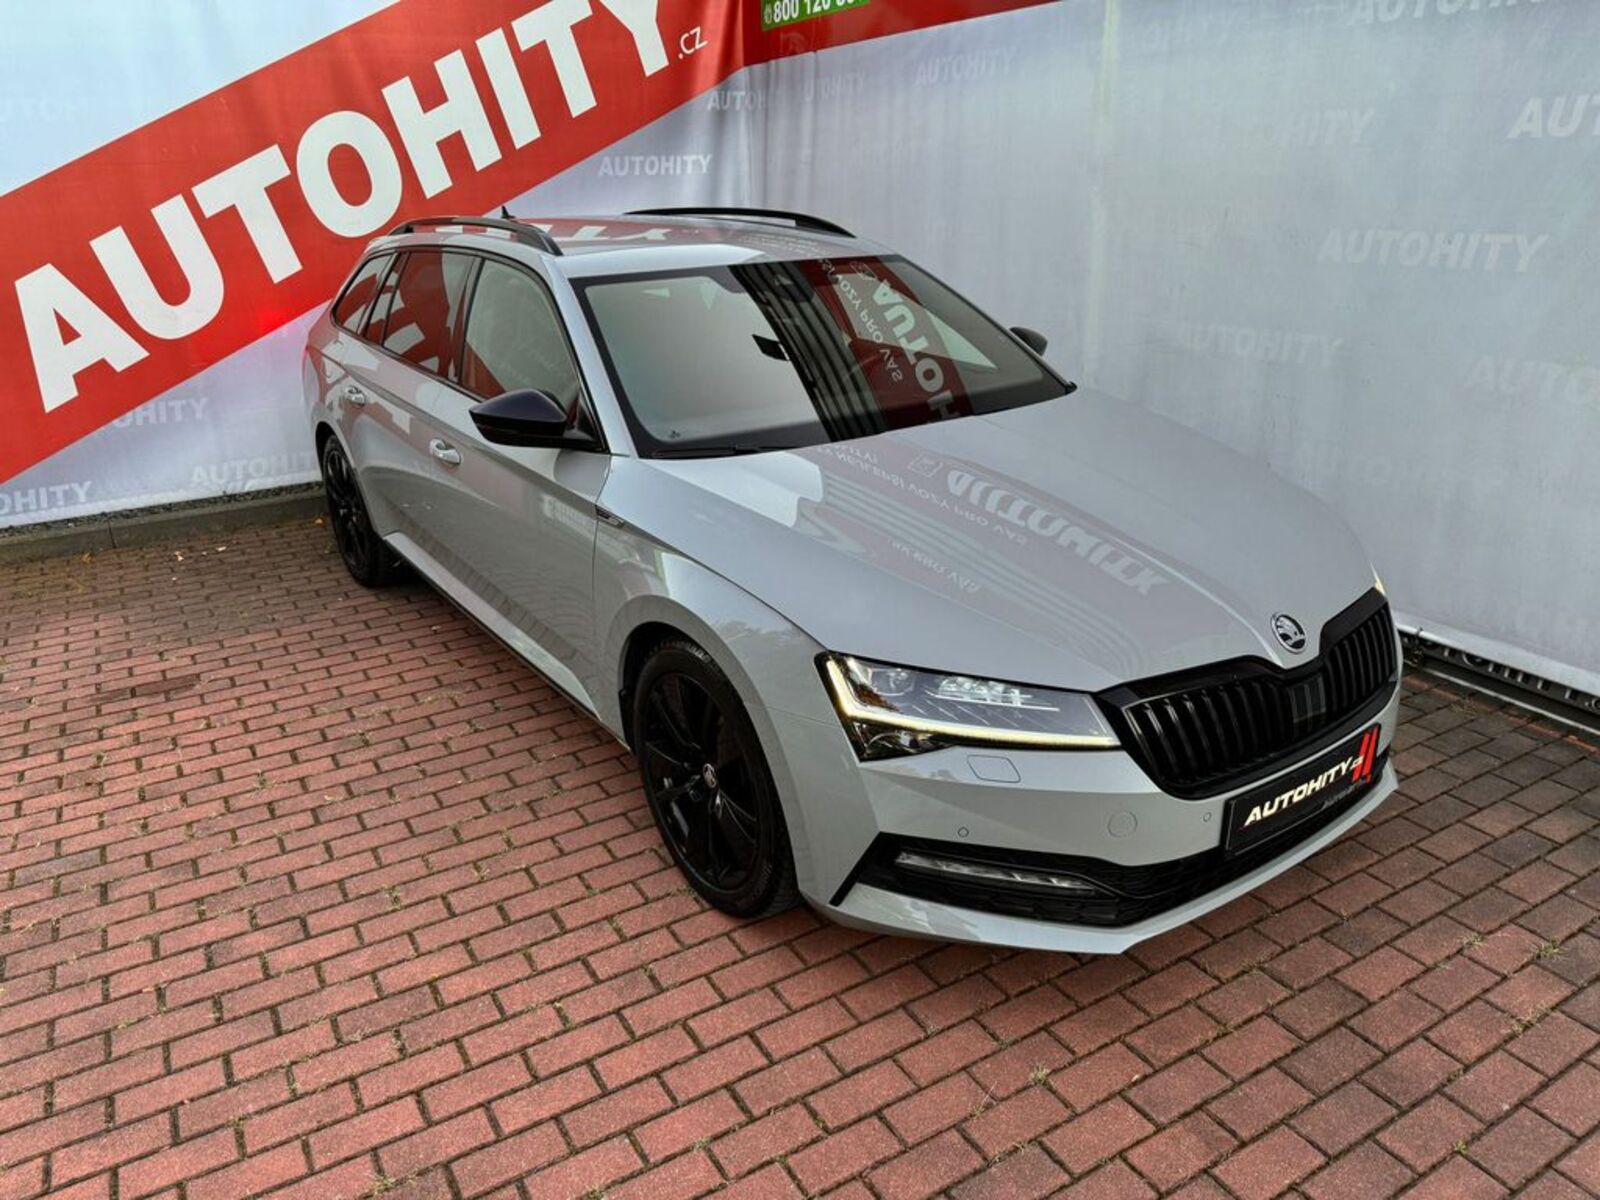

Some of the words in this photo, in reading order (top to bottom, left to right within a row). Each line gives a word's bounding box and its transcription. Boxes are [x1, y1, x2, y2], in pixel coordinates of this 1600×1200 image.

[773, 0, 800, 23] 800
[598, 154, 713, 177] AUTOHITY
[14, 0, 669, 413] AUTOHITY
[1317, 228, 1550, 274] AUTOHITY
[1243, 757, 1352, 826] AUTOHITY
